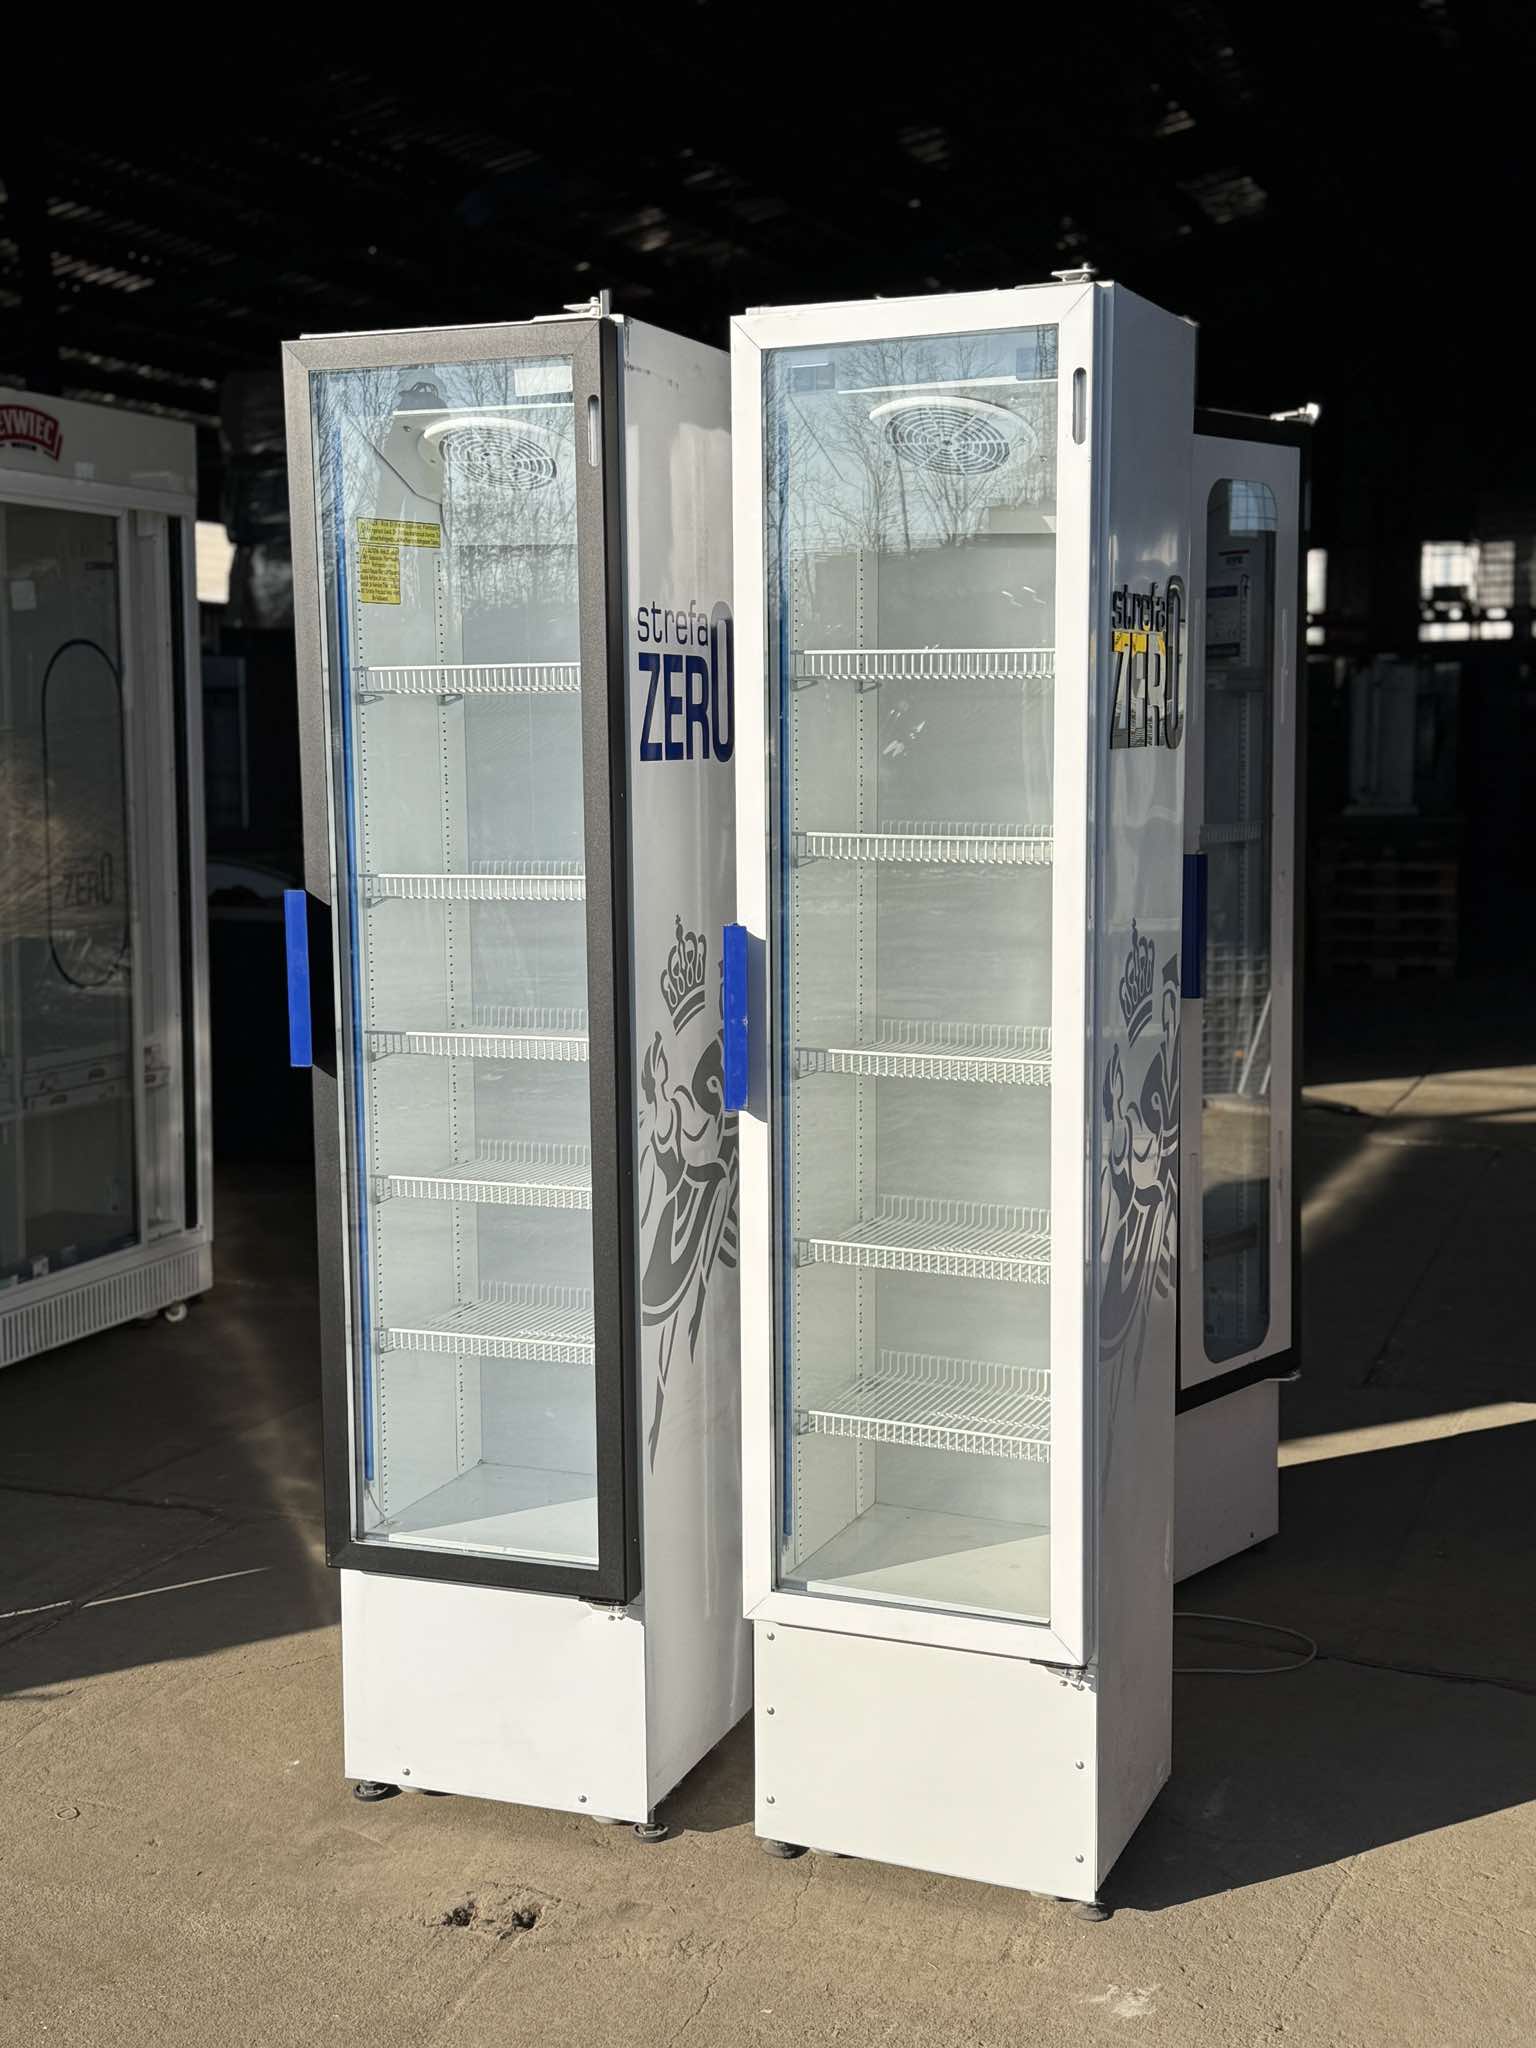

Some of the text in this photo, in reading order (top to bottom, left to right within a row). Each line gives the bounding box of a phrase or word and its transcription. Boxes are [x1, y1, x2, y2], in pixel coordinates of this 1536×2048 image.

[637, 600, 709, 647] strefa
[1111, 582, 1167, 631] strefa
[638, 600, 735, 763] ZERO
